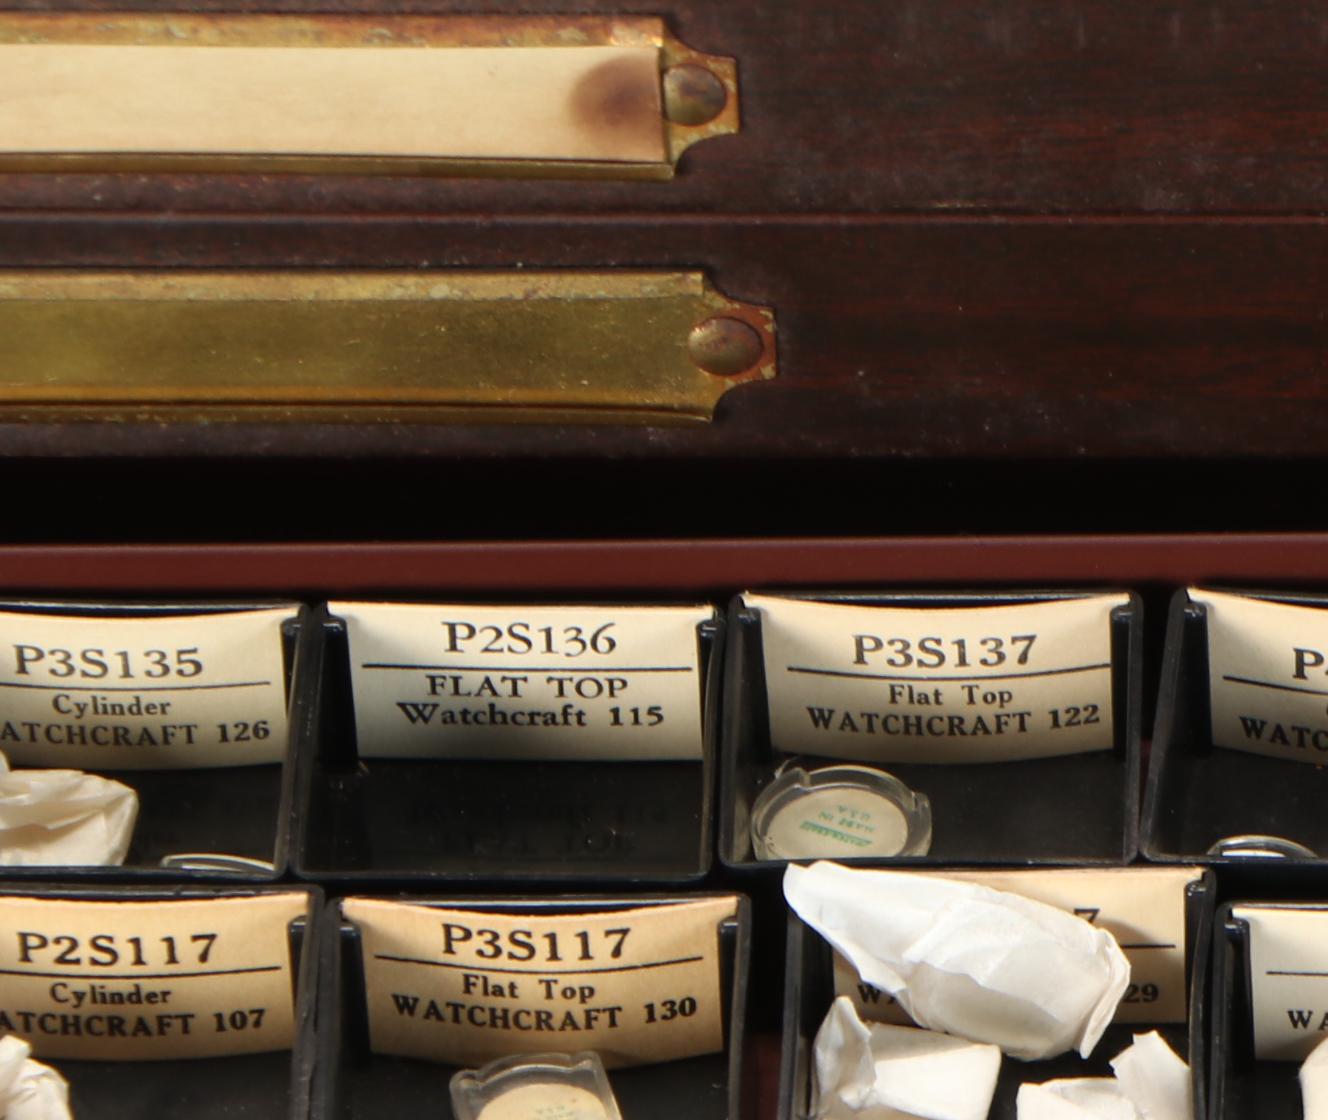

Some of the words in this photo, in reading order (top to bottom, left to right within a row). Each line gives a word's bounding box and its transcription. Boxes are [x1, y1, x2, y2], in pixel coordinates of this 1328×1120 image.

[443, 622, 616, 656] P2S136
[854, 635, 1036, 668] P3S137
[15, 645, 202, 678] P3S135
[426, 675, 528, 697] FLAT
[546, 677, 627, 698] TOP
[890, 685, 942, 705] Flat
[962, 685, 1012, 708] Top
[53, 695, 170, 719] Cylinder
[396, 702, 586, 726] Watchcraft
[610, 706, 663, 726] 115
[18, 932, 217, 966] P2S117
[442, 923, 630, 961] P3S117
[50, 983, 171, 1008] Cylinder
[463, 974, 518, 998] Flat
[539, 979, 595, 1004] Top
